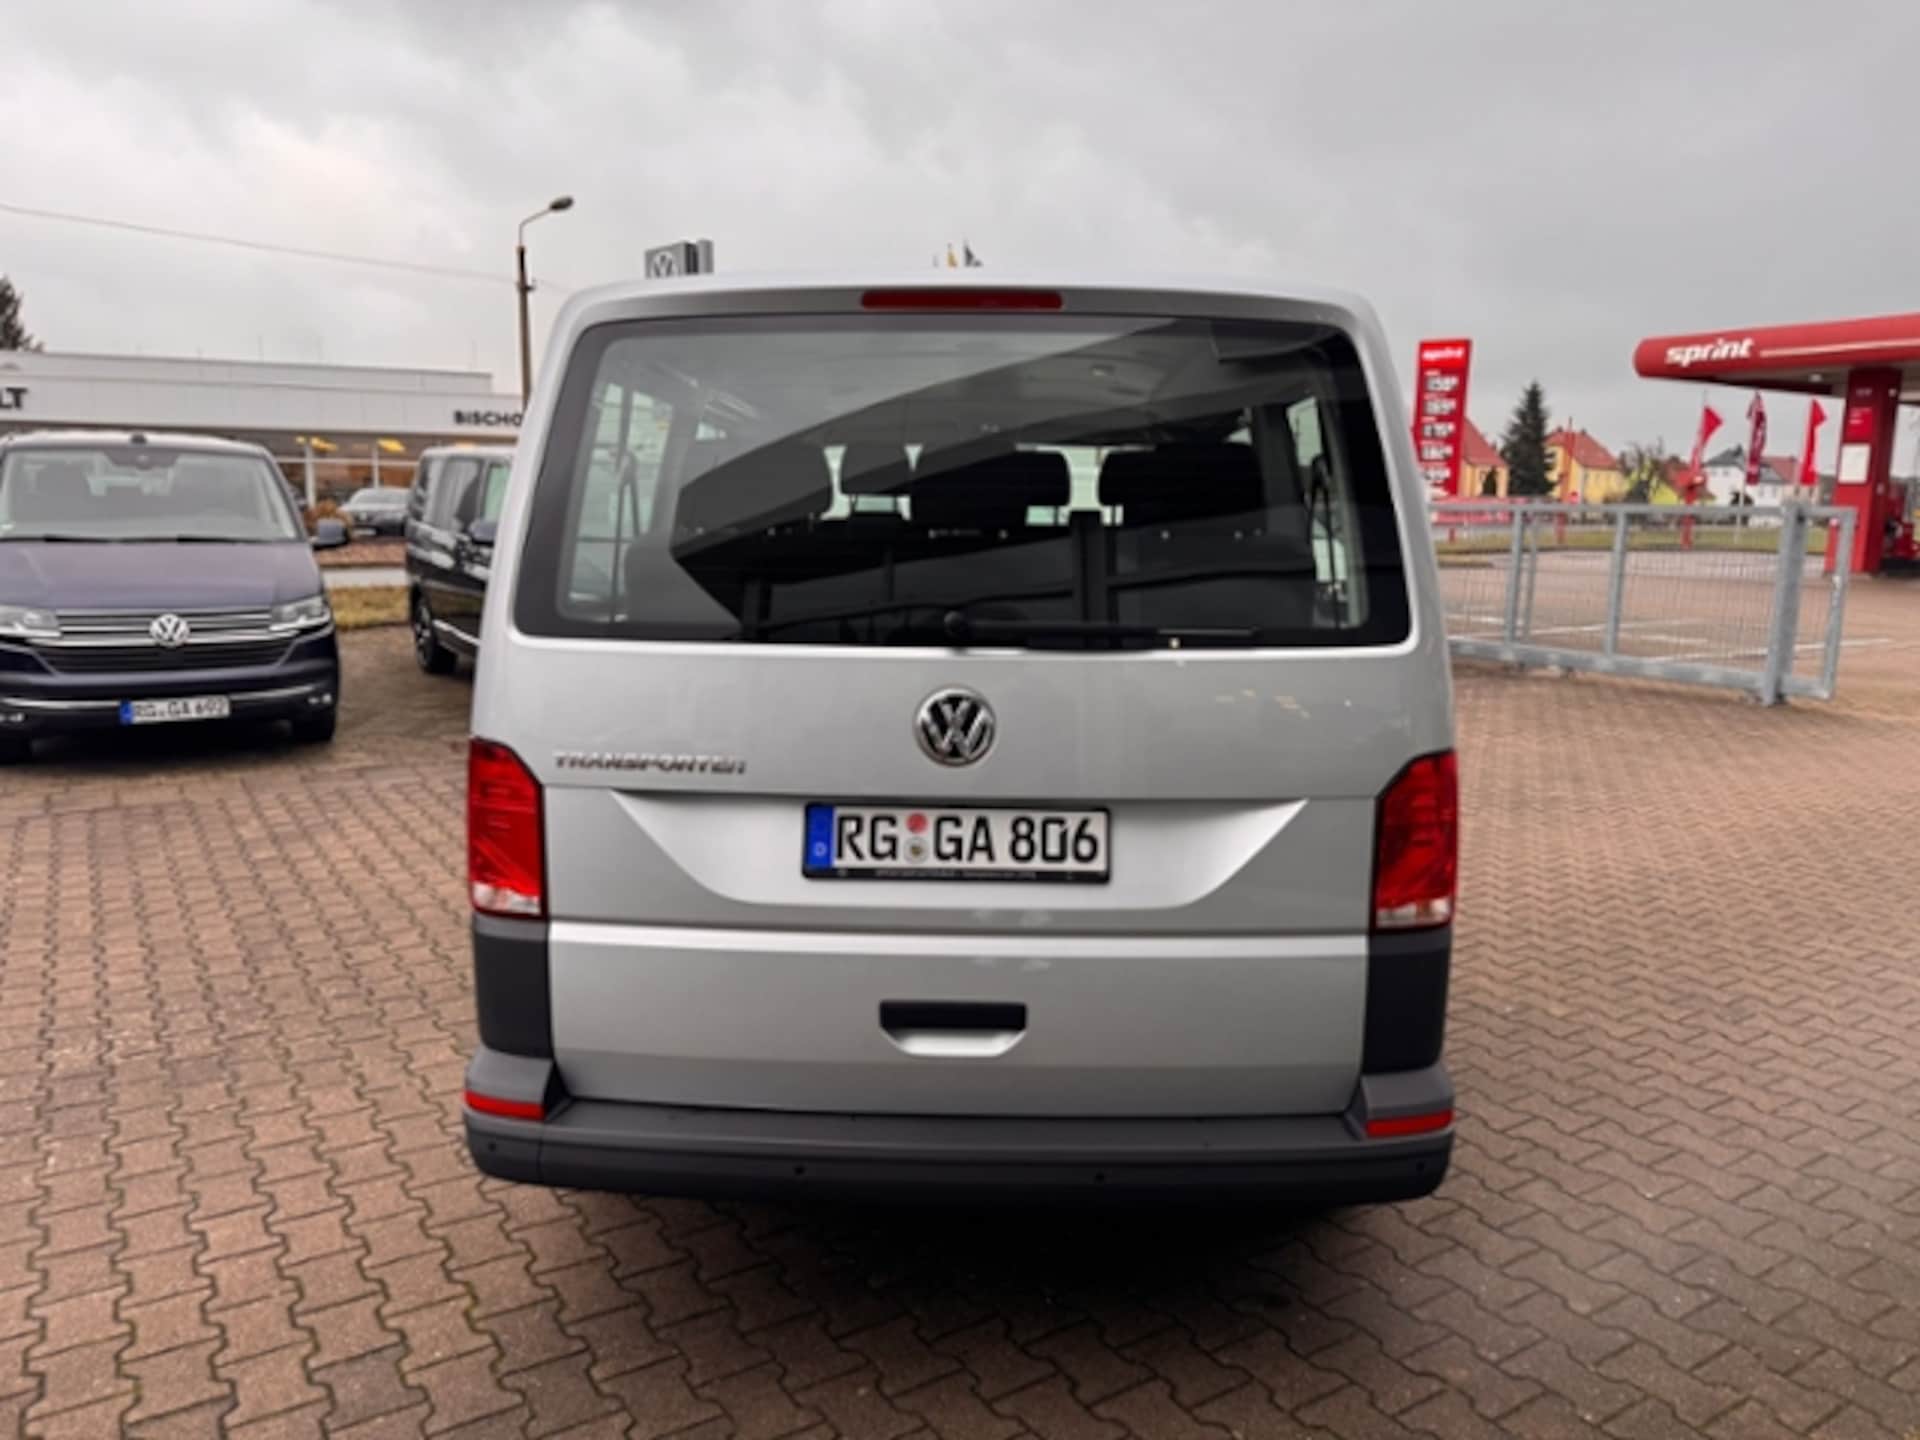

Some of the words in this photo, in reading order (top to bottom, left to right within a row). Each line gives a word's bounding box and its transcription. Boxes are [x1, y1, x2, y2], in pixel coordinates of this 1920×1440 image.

[1663, 337, 1754, 368] sprint
[553, 751, 748, 775] TRANSPORTER
[836, 814, 899, 862] RG
[934, 814, 996, 862] GA
[1009, 815, 1100, 864] 806
